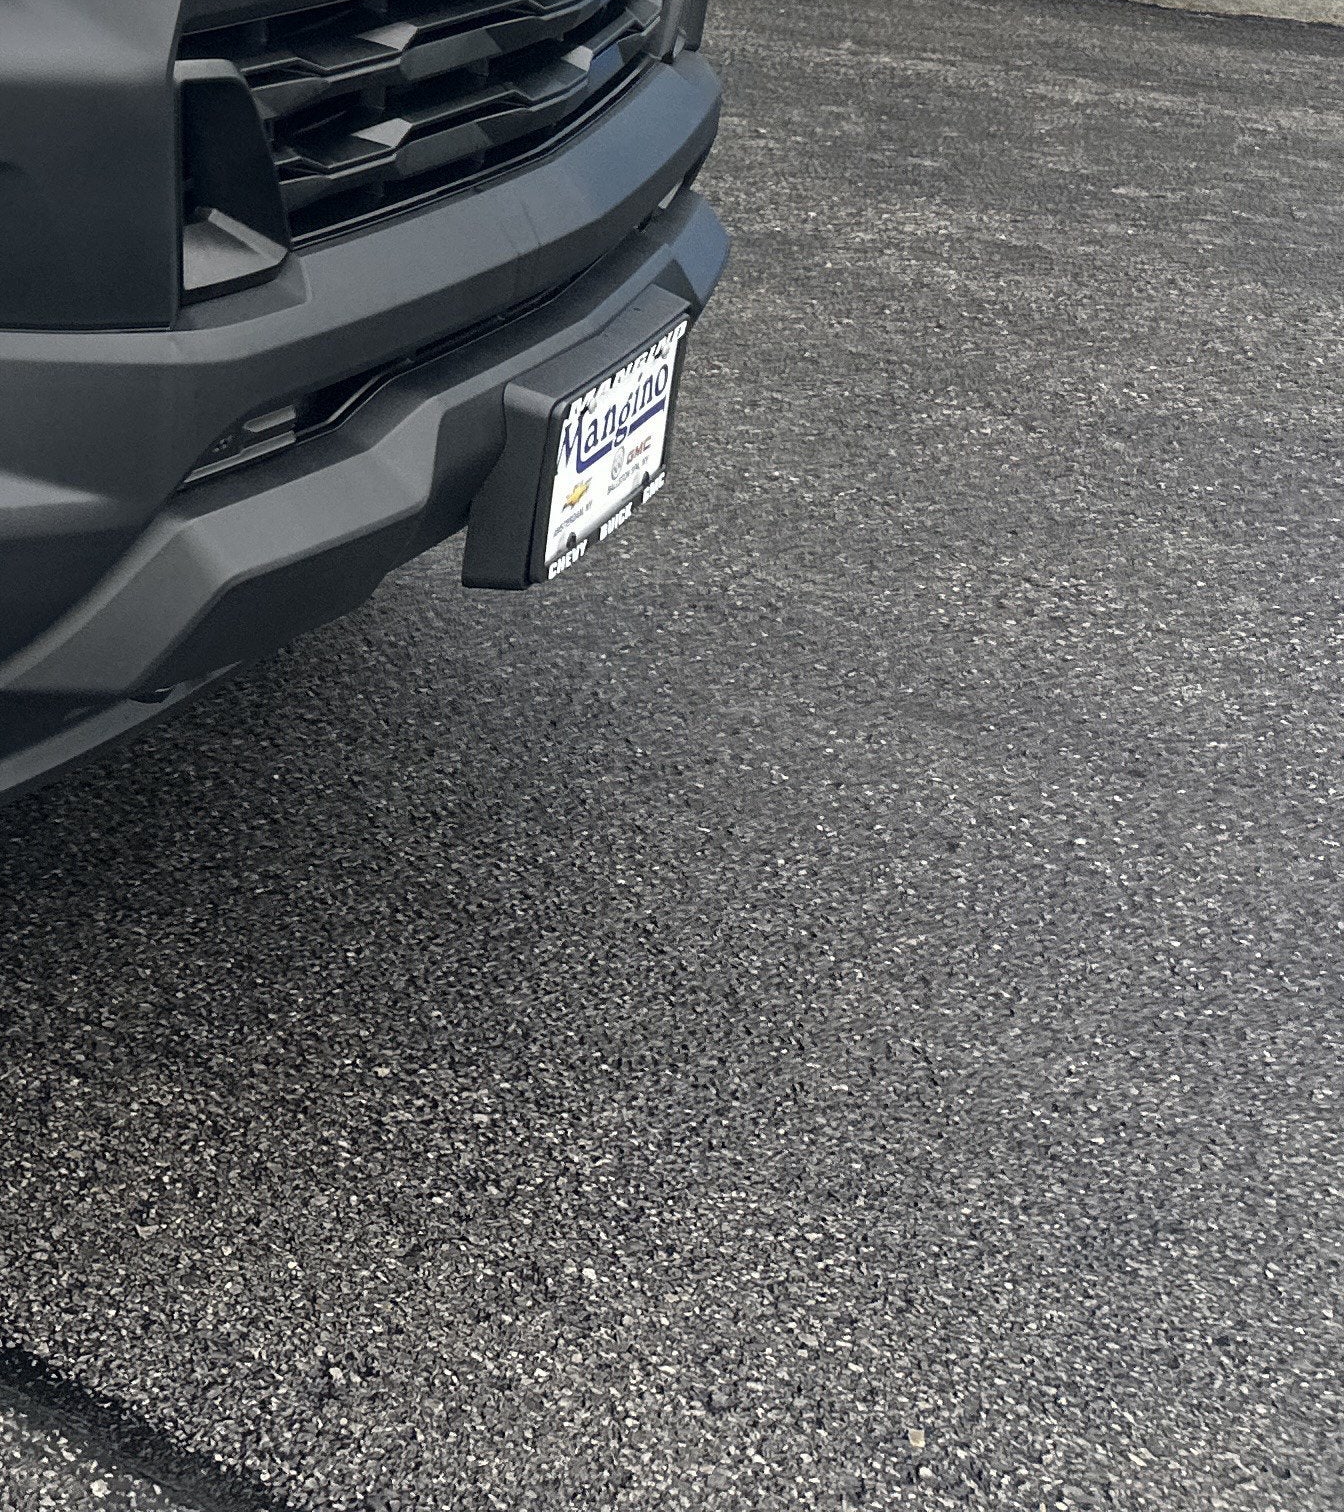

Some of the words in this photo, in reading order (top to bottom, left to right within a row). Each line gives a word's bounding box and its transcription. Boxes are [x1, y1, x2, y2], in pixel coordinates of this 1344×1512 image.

[557, 363, 669, 473] Mangino
[626, 435, 652, 465] GMC
[548, 539, 588, 580] CHEVY
[599, 501, 633, 541] BUICK
[642, 472, 666, 504] GMC
